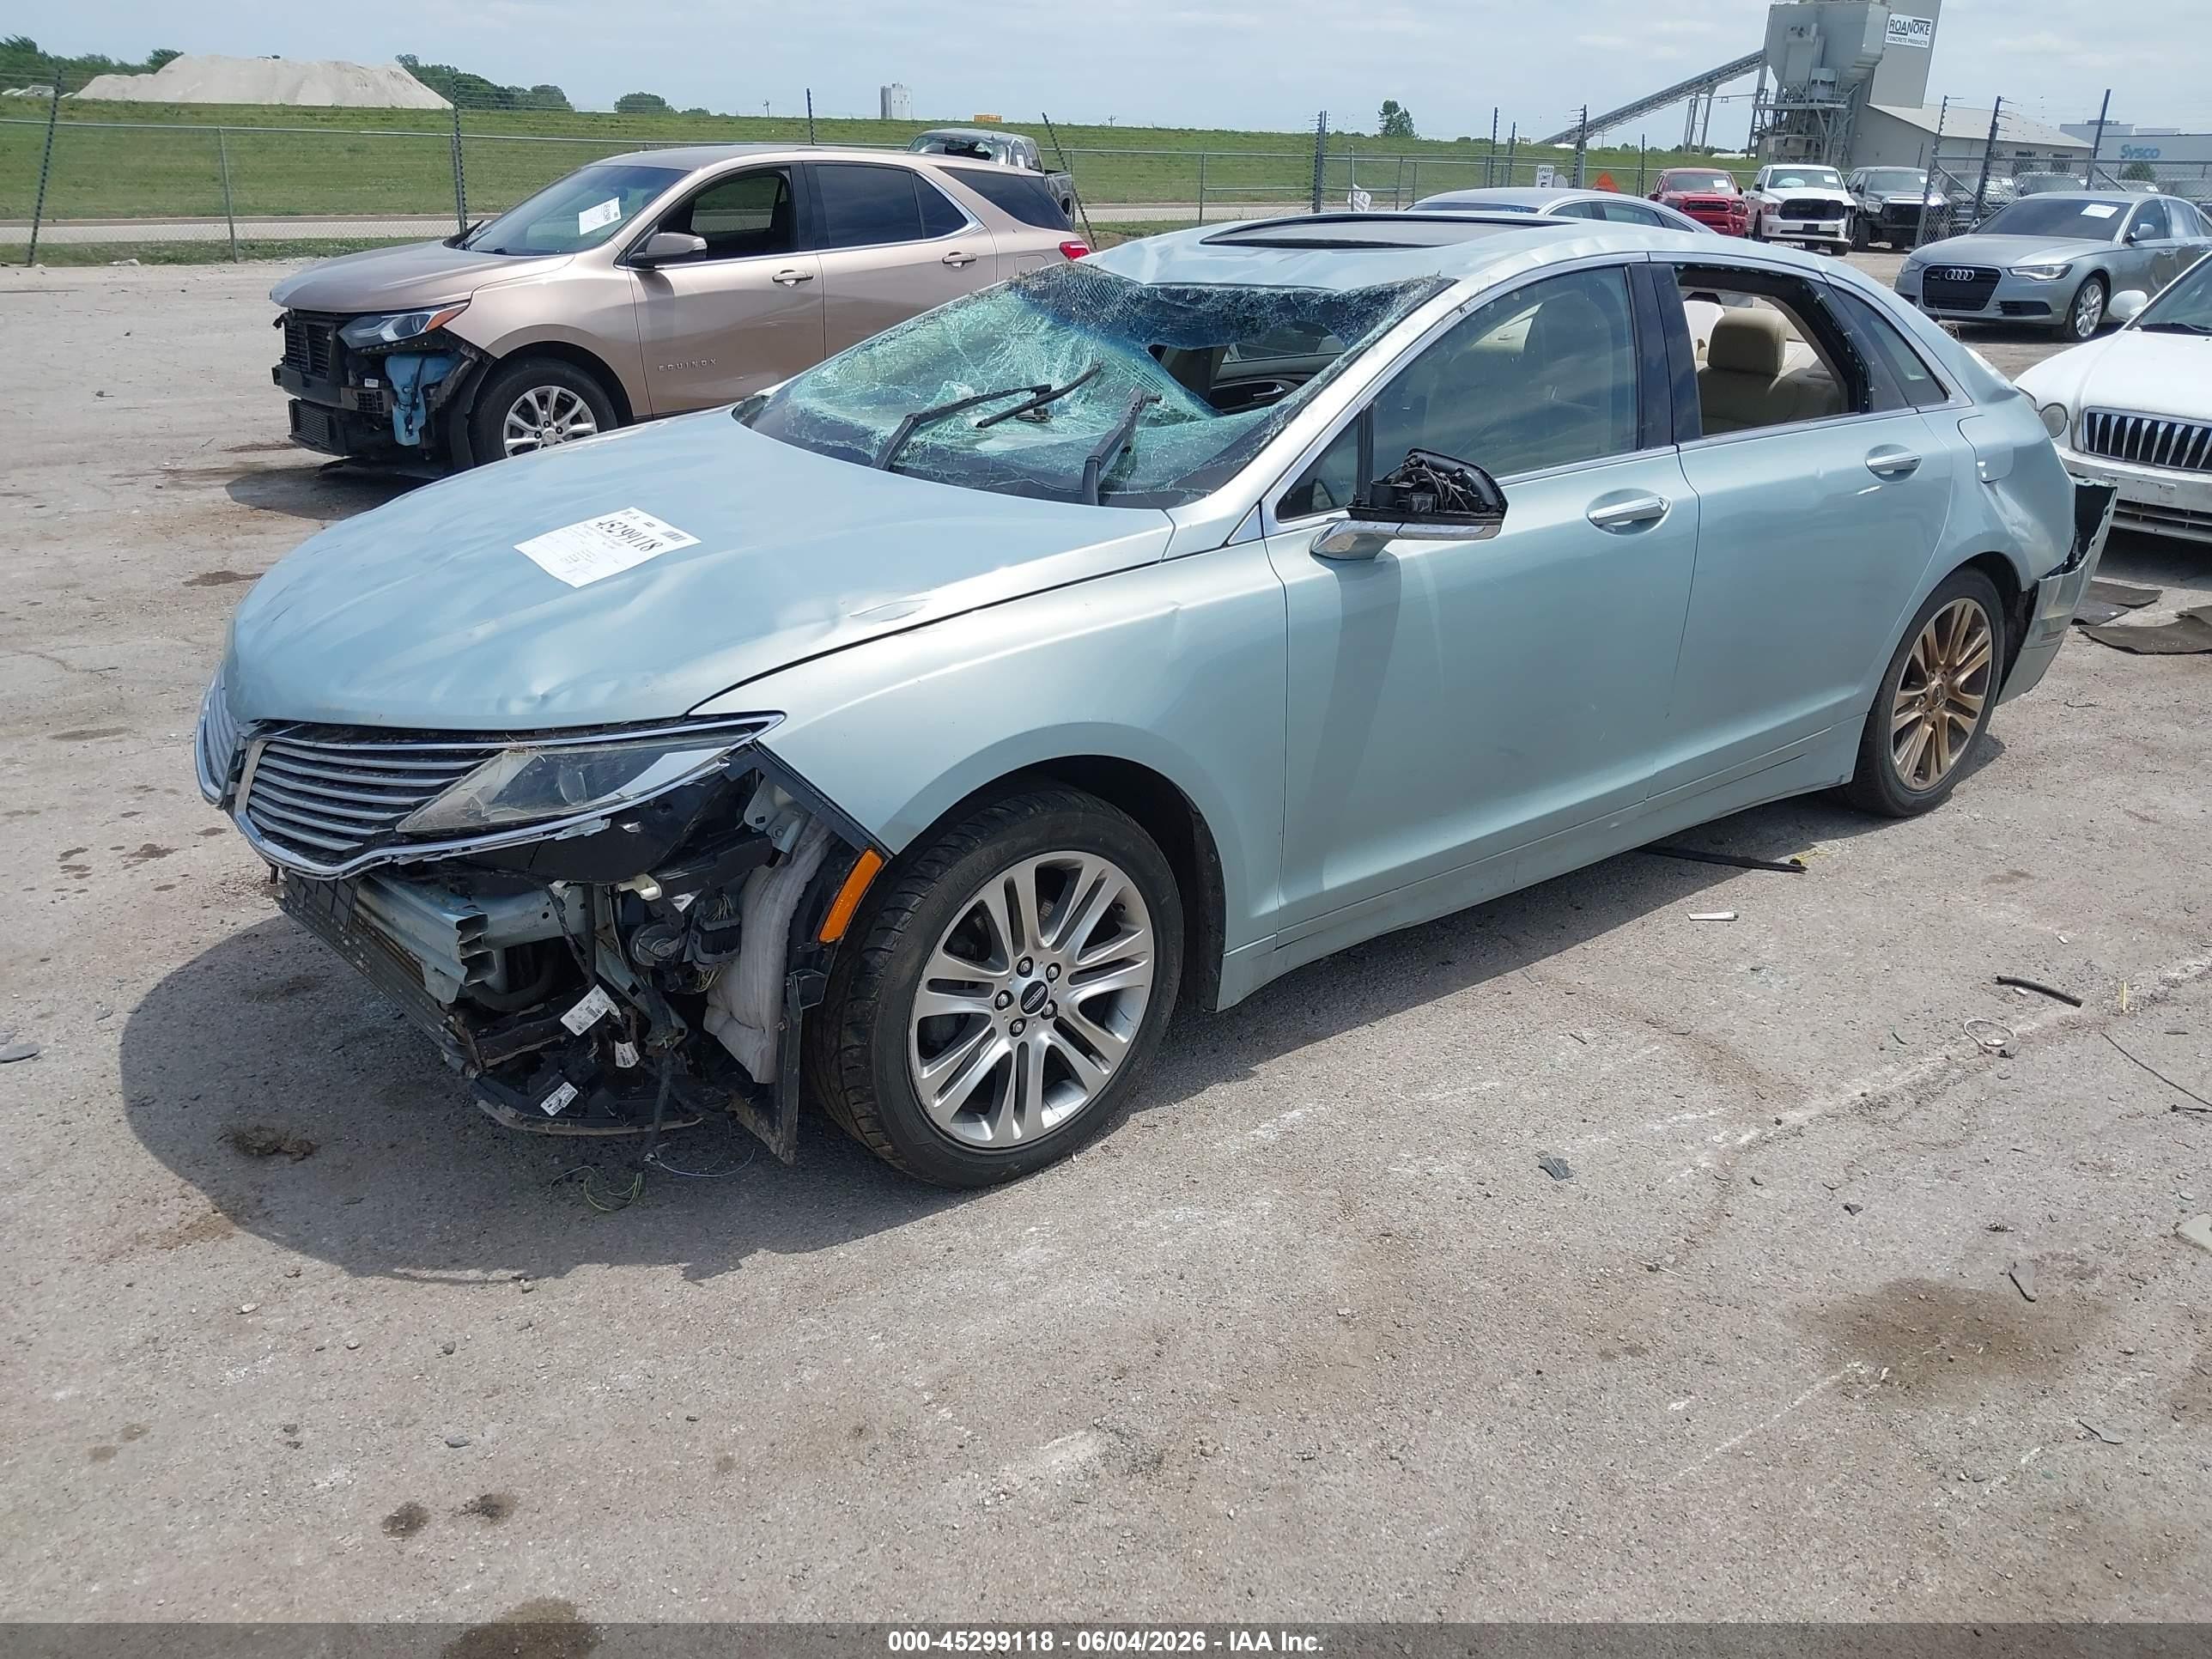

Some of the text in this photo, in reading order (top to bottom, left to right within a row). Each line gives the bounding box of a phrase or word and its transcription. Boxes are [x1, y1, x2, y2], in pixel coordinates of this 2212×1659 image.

[1889, 19, 1931, 35] ROANOKE
[1887, 35, 1928, 46] CONCRETE PRODUCTS
[2120, 144, 2160, 160] Sysco
[658, 358, 717, 372] EQUINOX
[595, 519, 664, 552] 45299118
